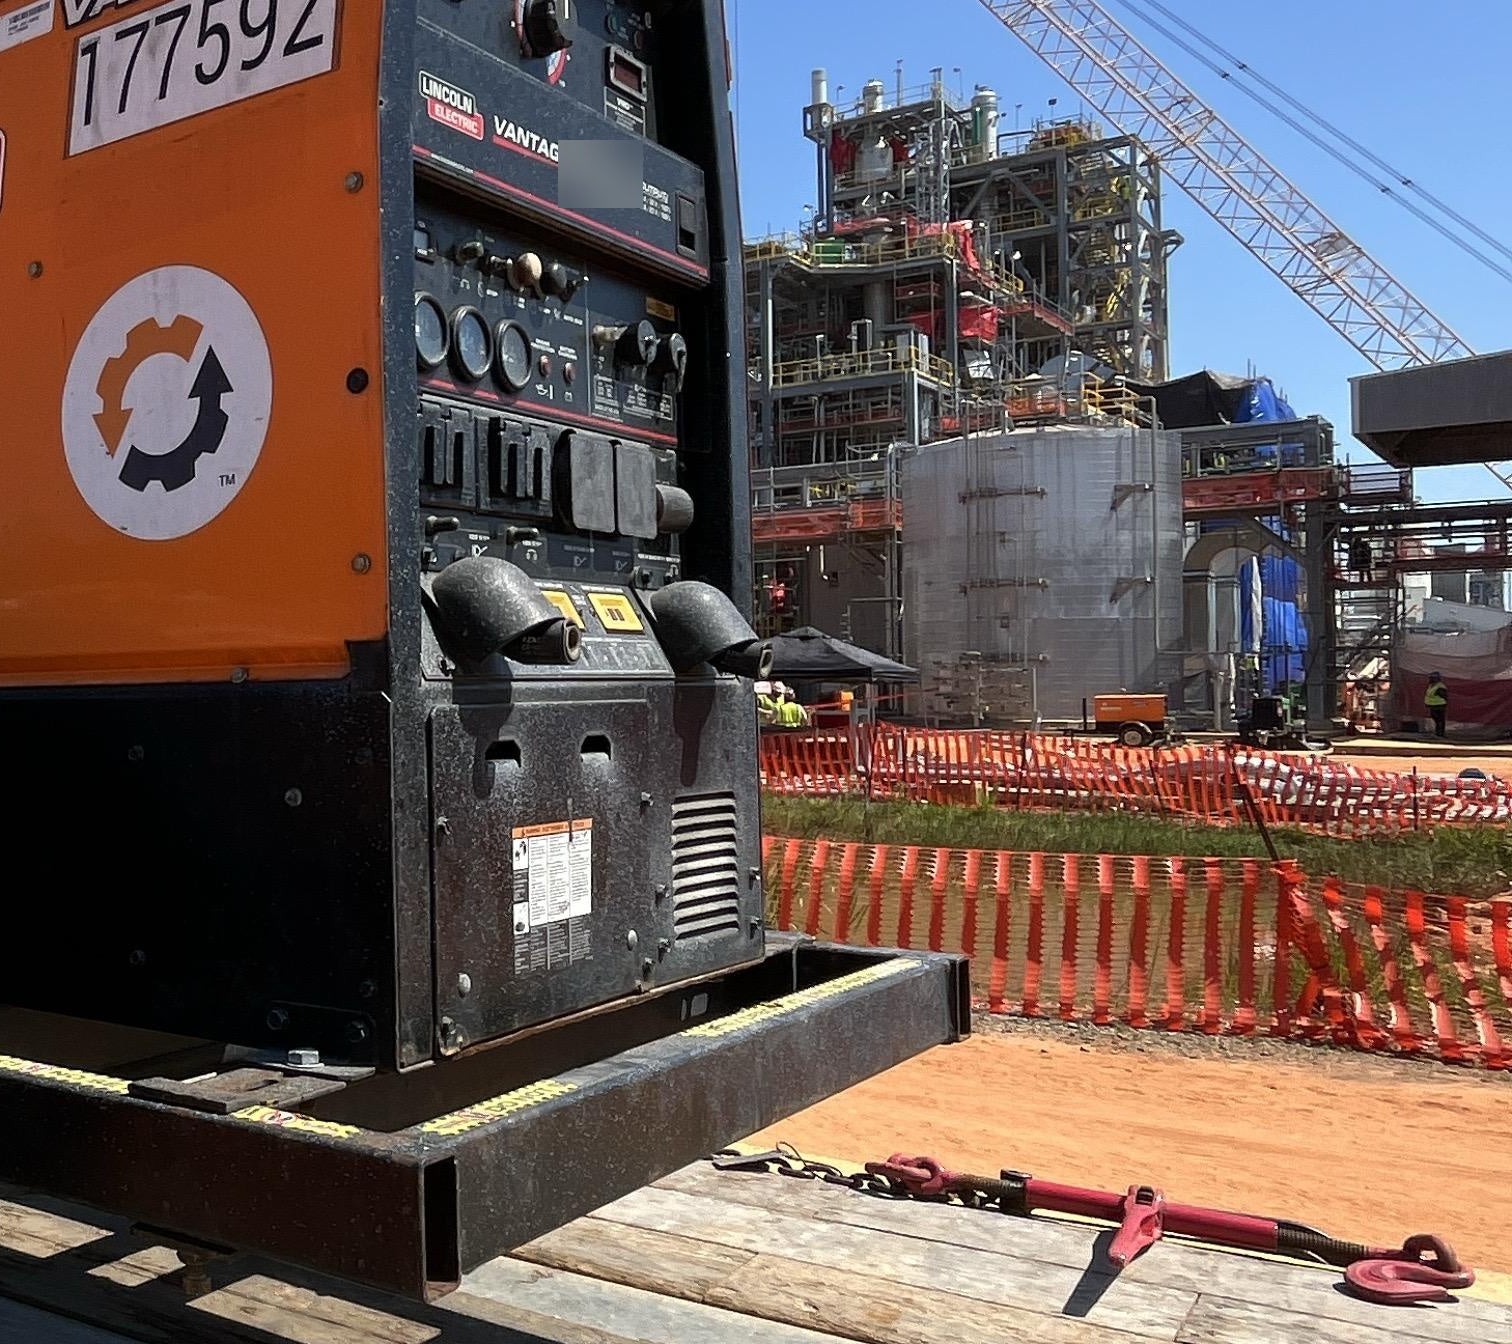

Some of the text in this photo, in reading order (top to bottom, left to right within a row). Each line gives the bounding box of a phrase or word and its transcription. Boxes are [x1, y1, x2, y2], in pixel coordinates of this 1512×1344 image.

[422, 76, 474, 115] LINCOLN
[434, 103, 478, 134] ELECTRIC
[493, 115, 559, 163] VANTAG
[219, 473, 236, 487] TM
